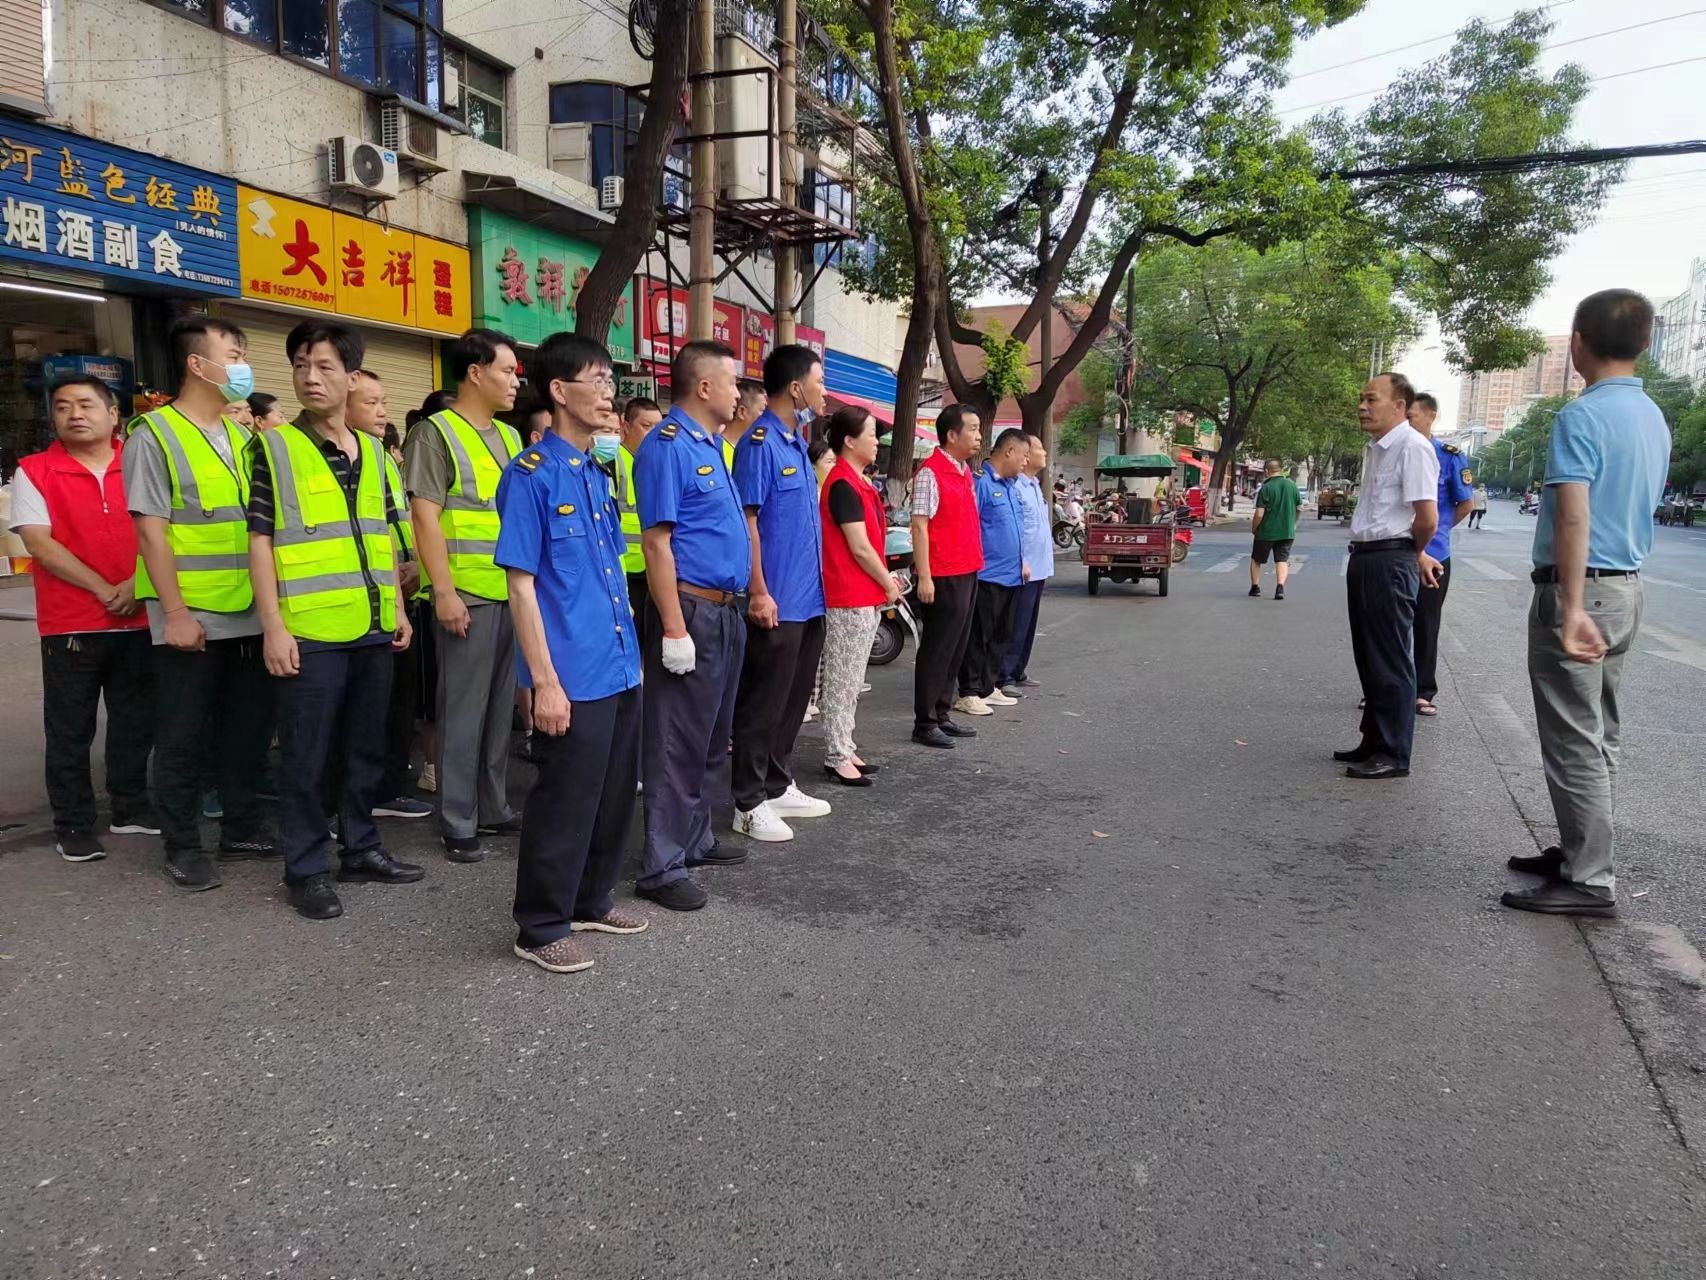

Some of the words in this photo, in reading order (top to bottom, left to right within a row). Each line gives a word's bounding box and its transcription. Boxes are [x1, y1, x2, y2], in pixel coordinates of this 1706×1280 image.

[2, 197, 183, 278] 烟酒副食
[282, 218, 415, 316] 大吉祥
[620, 379, 651, 399] 茶叶
